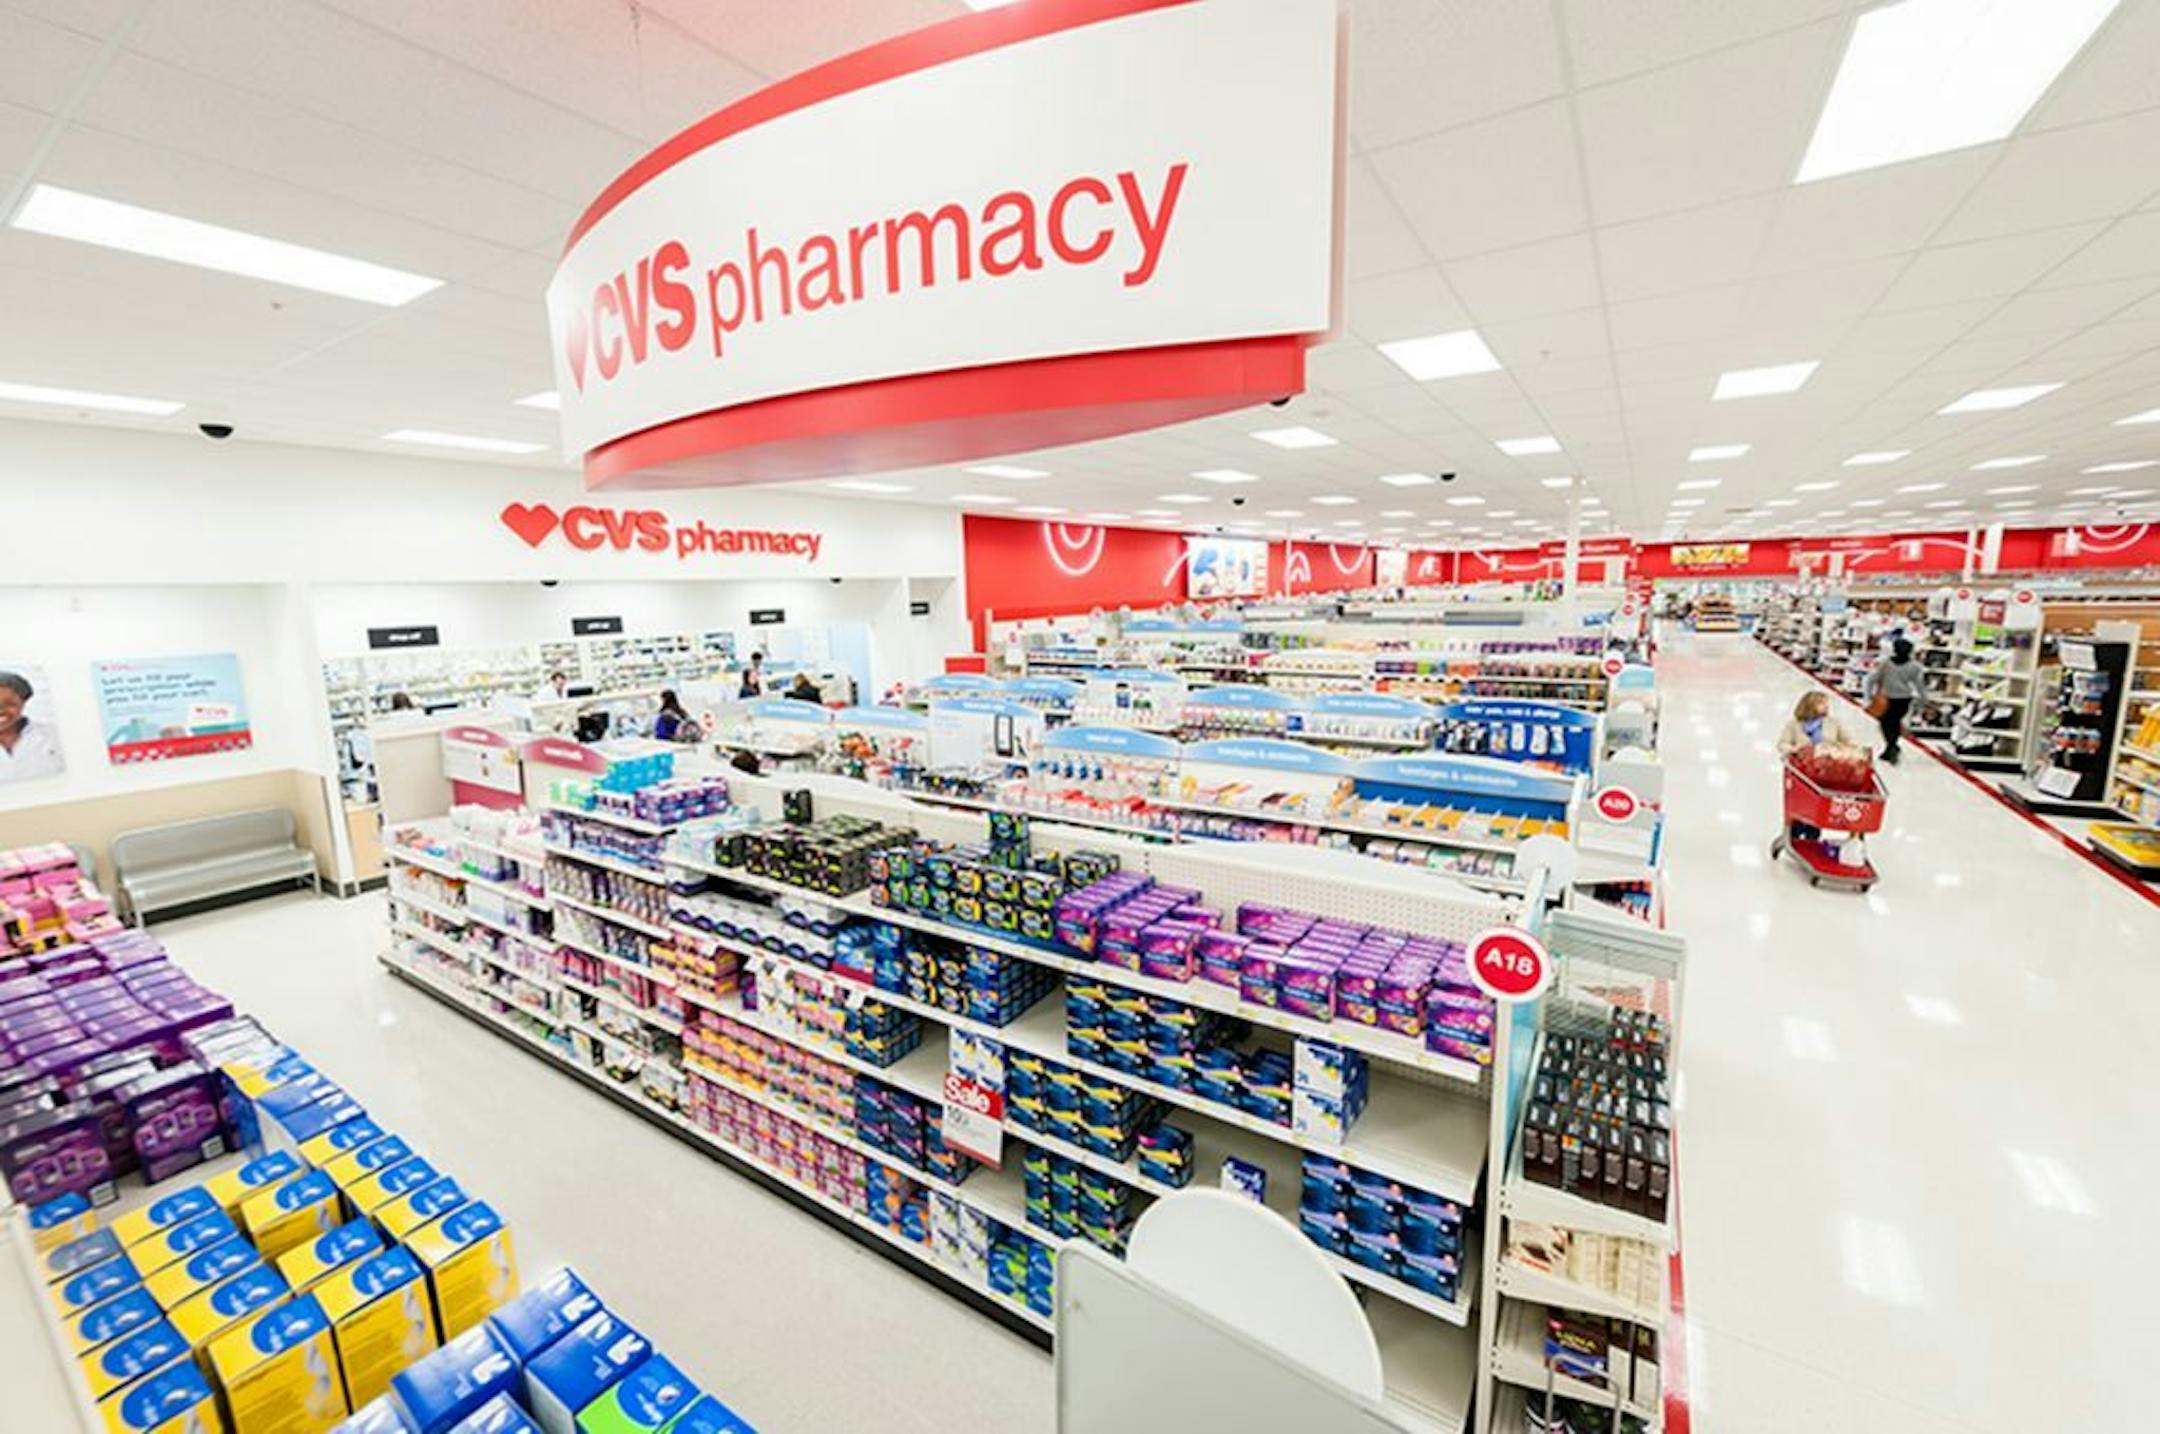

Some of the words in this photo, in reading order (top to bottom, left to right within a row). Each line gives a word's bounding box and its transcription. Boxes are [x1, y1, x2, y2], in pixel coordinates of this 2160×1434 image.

[591, 241, 696, 381] CVS
[708, 163, 1189, 358] pharmacy
[562, 506, 671, 552] CVS
[676, 519, 822, 562] pharmacy
[1483, 947, 1534, 977] A18
[945, 1076, 990, 1113] Sale
